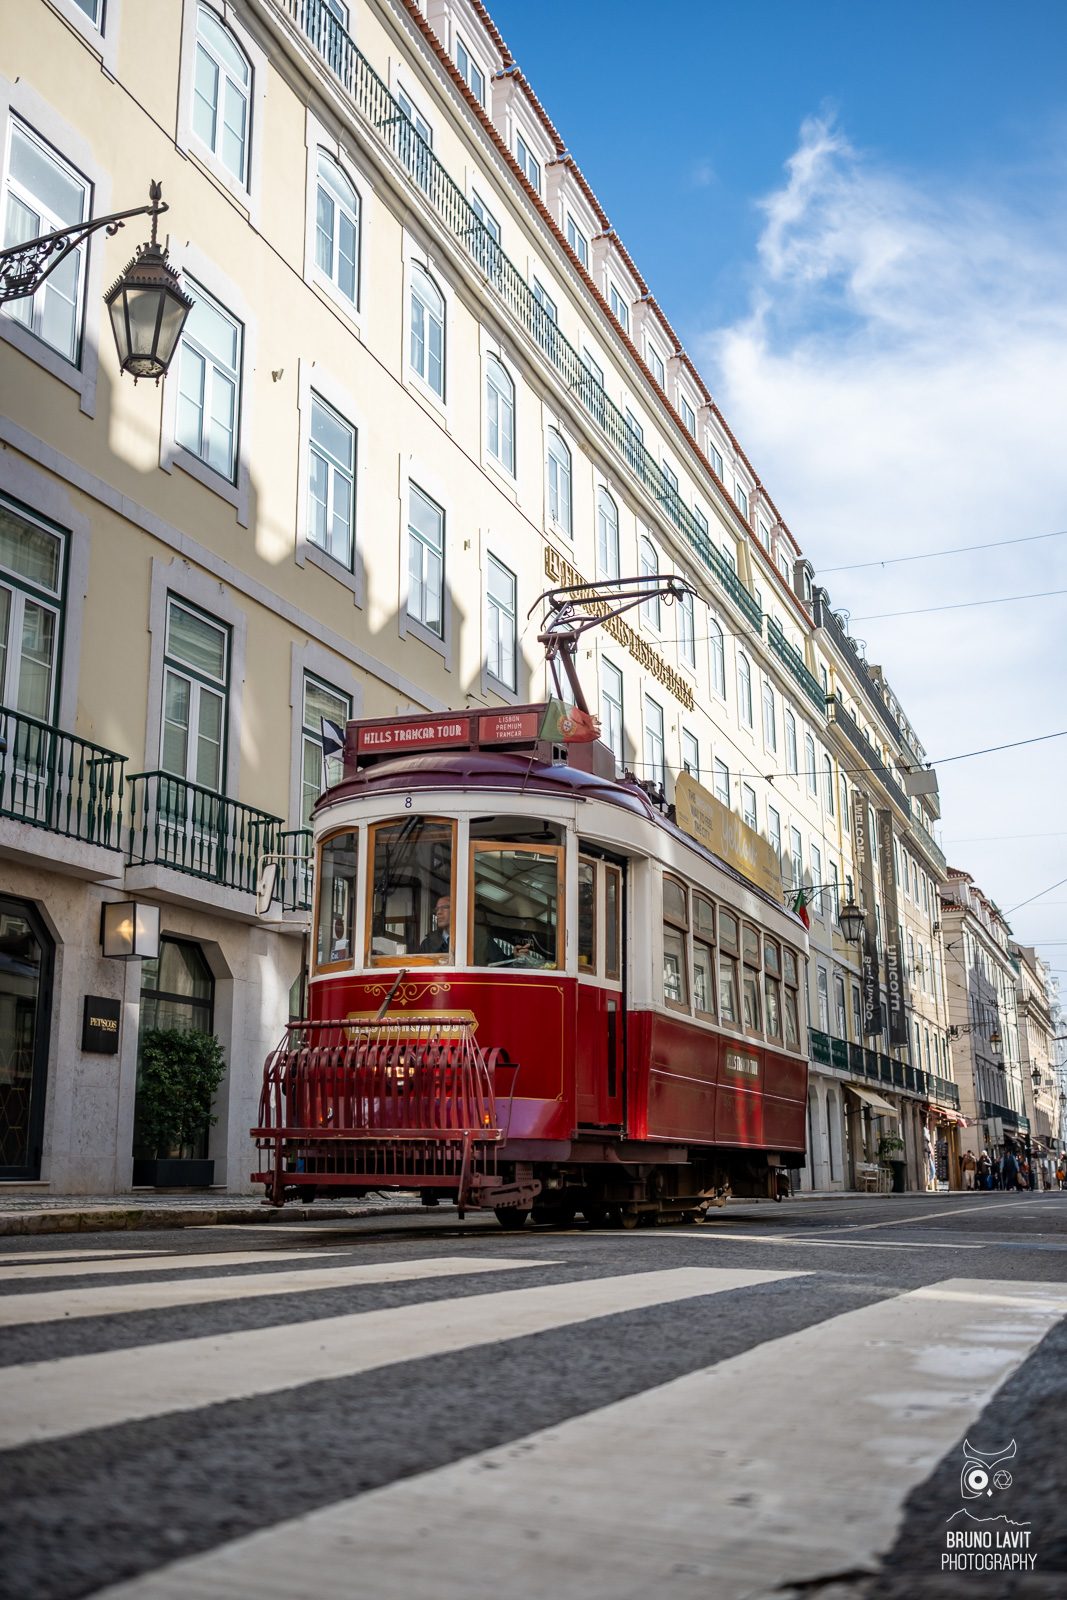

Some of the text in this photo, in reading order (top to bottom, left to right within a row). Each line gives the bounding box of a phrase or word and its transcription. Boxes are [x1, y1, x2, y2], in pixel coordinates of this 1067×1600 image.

[498, 715, 520, 724] LISBON
[495, 723, 522, 731] PREMIUM
[364, 724, 462, 745] HILLS TRAMCAR TOUR
[495, 730, 522, 738] TRAMCAR
[405, 796, 412, 809] 8
[855, 804, 865, 864] WELCOME
